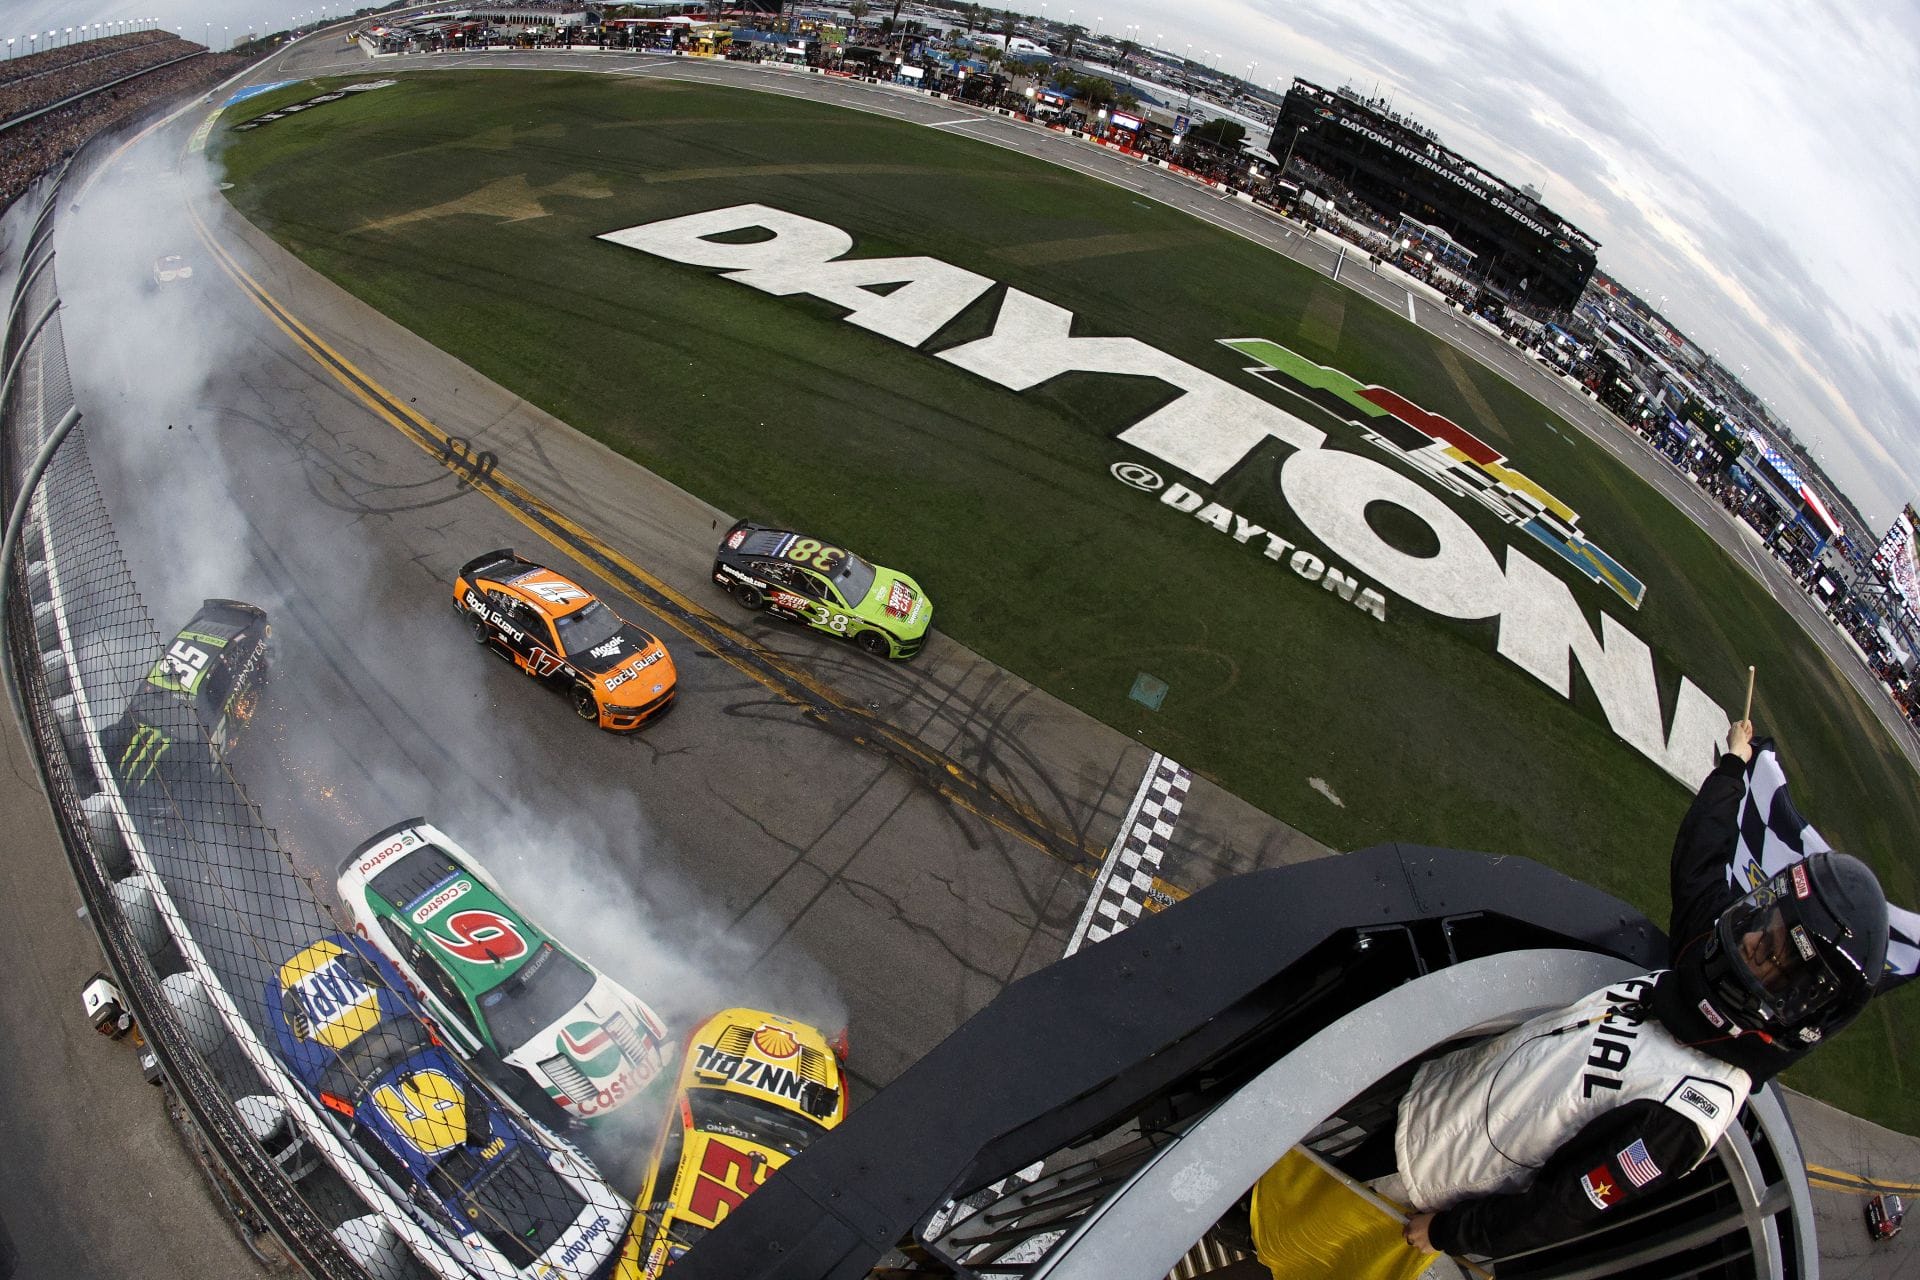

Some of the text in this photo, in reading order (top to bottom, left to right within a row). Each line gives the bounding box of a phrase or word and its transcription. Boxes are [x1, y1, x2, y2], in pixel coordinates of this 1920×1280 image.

[1339, 117, 1551, 239] DAYTONA INTERNATIONAL SPEEDWAY
[788, 539, 845, 571] 38
[1110, 462, 1386, 622] @DAYTONA
[777, 591, 811, 607] SPEEDY
[466, 590, 524, 644] Body Guard
[811, 606, 849, 633] 38
[527, 646, 565, 677] 17
[590, 635, 625, 659] Mosaic
[159, 640, 209, 690] 35
[604, 667, 638, 692] Body
[633, 648, 666, 673] Guard
[359, 841, 404, 876] Castrol
[416, 887, 460, 921] Castrol
[422, 909, 529, 965] 6
[1701, 1002, 1721, 1026] SIMPSON
[577, 1056, 658, 1115] Castrol
[1683, 1089, 1717, 1117] SIMPSON
[706, 1122, 750, 1140] LOGANO
[561, 1213, 611, 1268] AUTO PARTS
